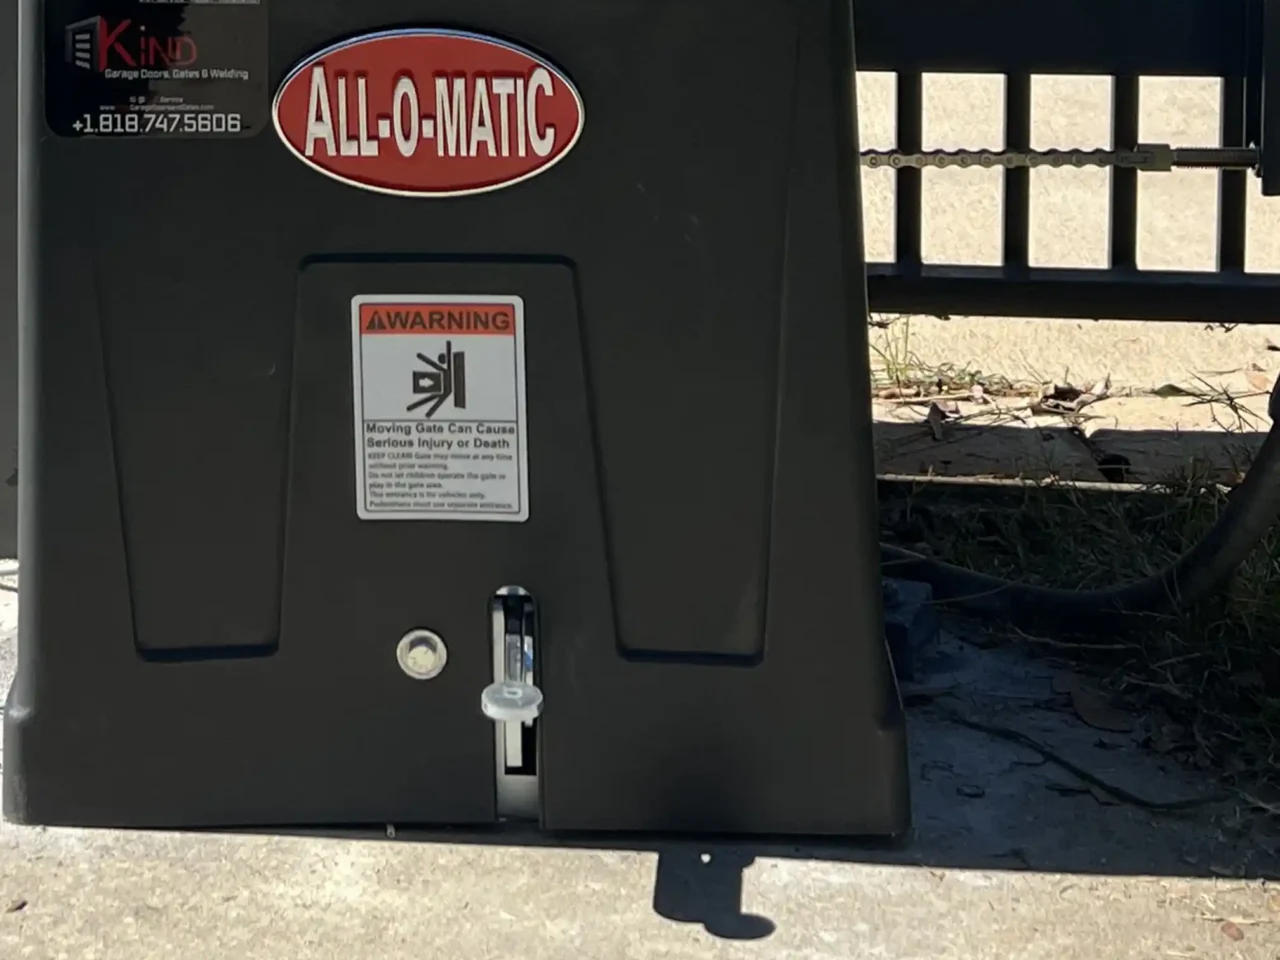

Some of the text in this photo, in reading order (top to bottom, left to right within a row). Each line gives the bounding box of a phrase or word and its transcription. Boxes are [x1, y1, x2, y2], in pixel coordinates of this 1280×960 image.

[105, 69, 139, 80] Garage
[172, 69, 200, 79] Gates
[210, 69, 248, 80] Welding
[305, 65, 555, 158] ALL-O-MATIC
[72, 113, 242, 133] +1.818.747.5606
[386, 311, 510, 330] WARNING
[367, 422, 515, 436] Moving Gate Can Cause
[367, 437, 510, 450] Serious Injury or Death
